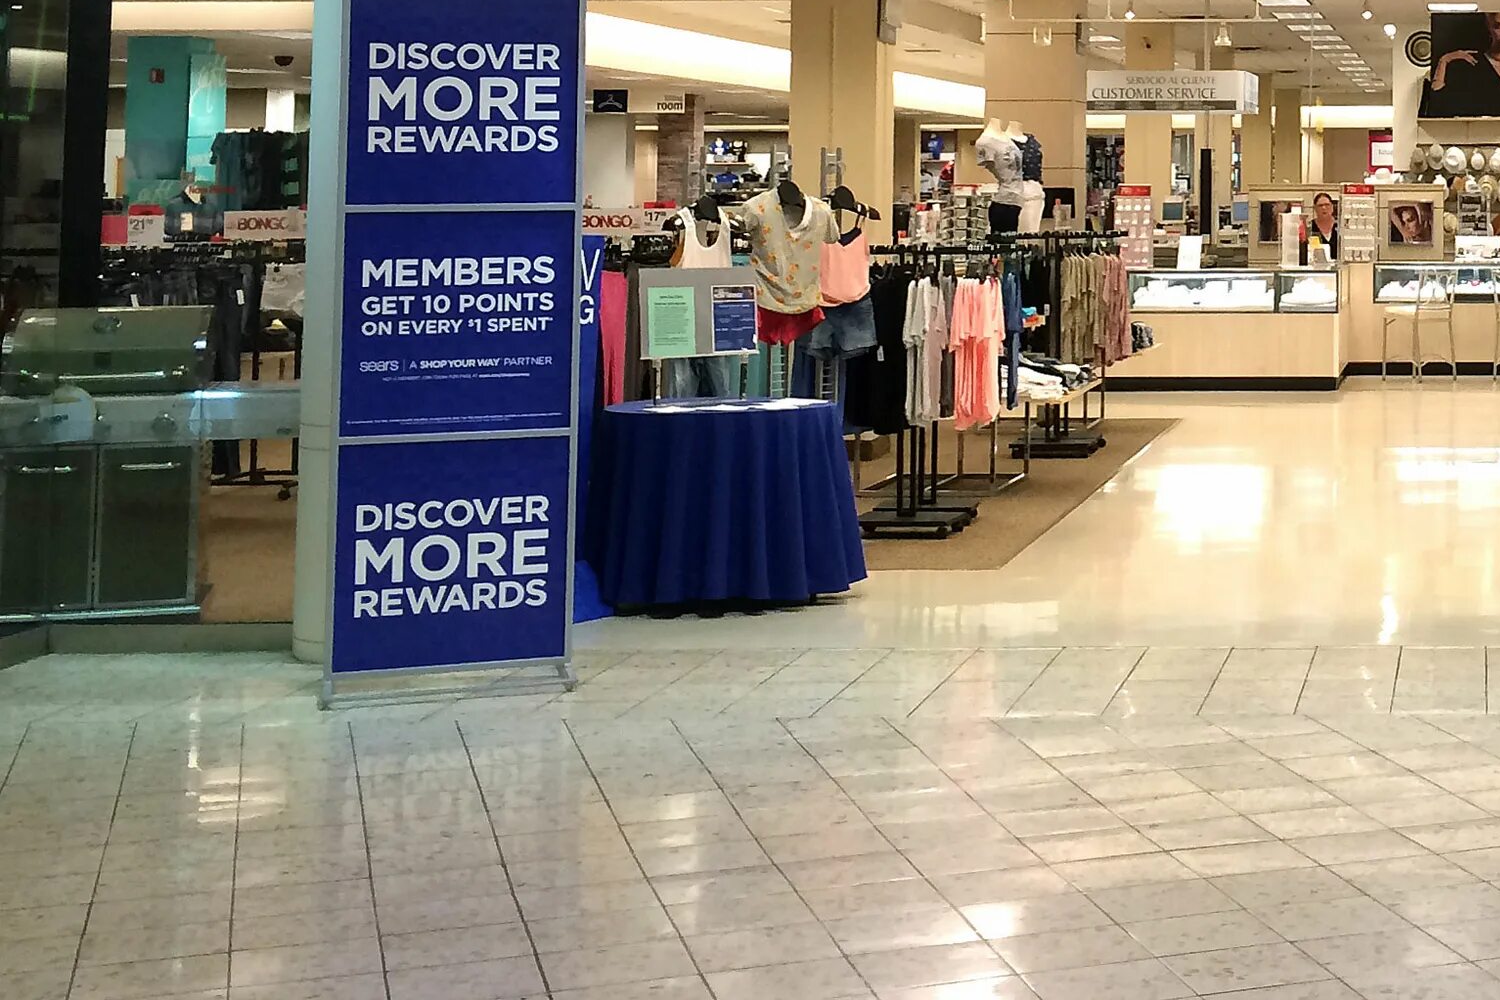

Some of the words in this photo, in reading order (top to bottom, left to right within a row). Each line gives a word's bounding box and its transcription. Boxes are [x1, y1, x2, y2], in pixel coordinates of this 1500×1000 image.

[369, 42, 560, 70] DISCOVER
[1092, 87, 1164, 99] CUSTOMER
[1166, 87, 1217, 99] SERVICE
[1126, 75, 1166, 85] SERVICIO
[368, 76, 561, 121] MORE
[657, 102, 683, 111] room
[367, 125, 559, 153] REWARDS
[361, 256, 555, 288] MEMBERS
[361, 295, 415, 316] GET
[422, 294, 451, 314] 10
[459, 292, 554, 313] POINTS
[361, 321, 392, 336] ON
[398, 319, 463, 335] EVERY
[468, 318, 482, 333] $1
[359, 360, 399, 372] sears
[409, 361, 418, 369] A
[503, 356, 553, 367] PARTNER
[355, 495, 550, 532] DISCOVER
[354, 528, 550, 585] MORE
[353, 579, 548, 618] REWARDS
